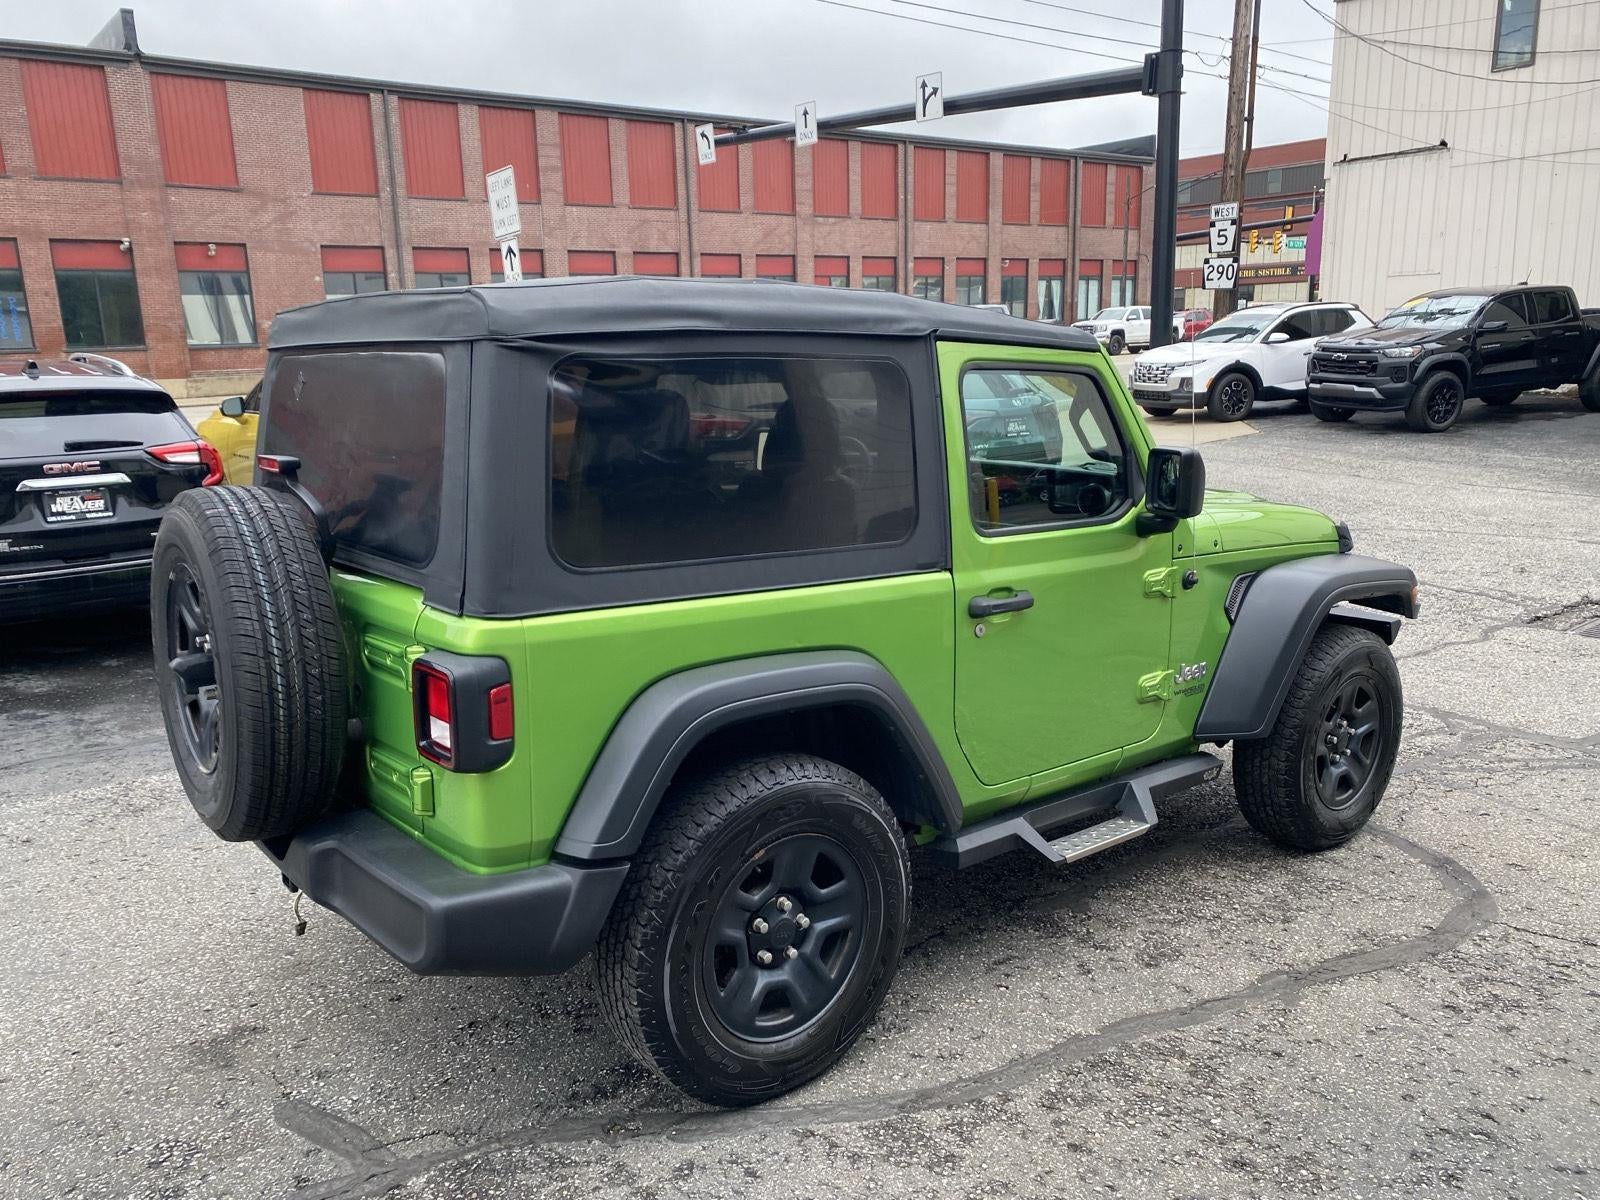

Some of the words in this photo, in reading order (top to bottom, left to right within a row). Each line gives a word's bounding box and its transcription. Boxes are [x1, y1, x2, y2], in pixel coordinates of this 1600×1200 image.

[800, 131, 814, 140] ONLY
[495, 195, 511, 211] MUST
[1213, 206, 1236, 218] WEST
[1217, 228, 1228, 246] 5
[1206, 263, 1235, 281] 290
[43, 460, 101, 475] GMC
[50, 499, 105, 513] WEAVER
[1173, 661, 1207, 684] Jeep
